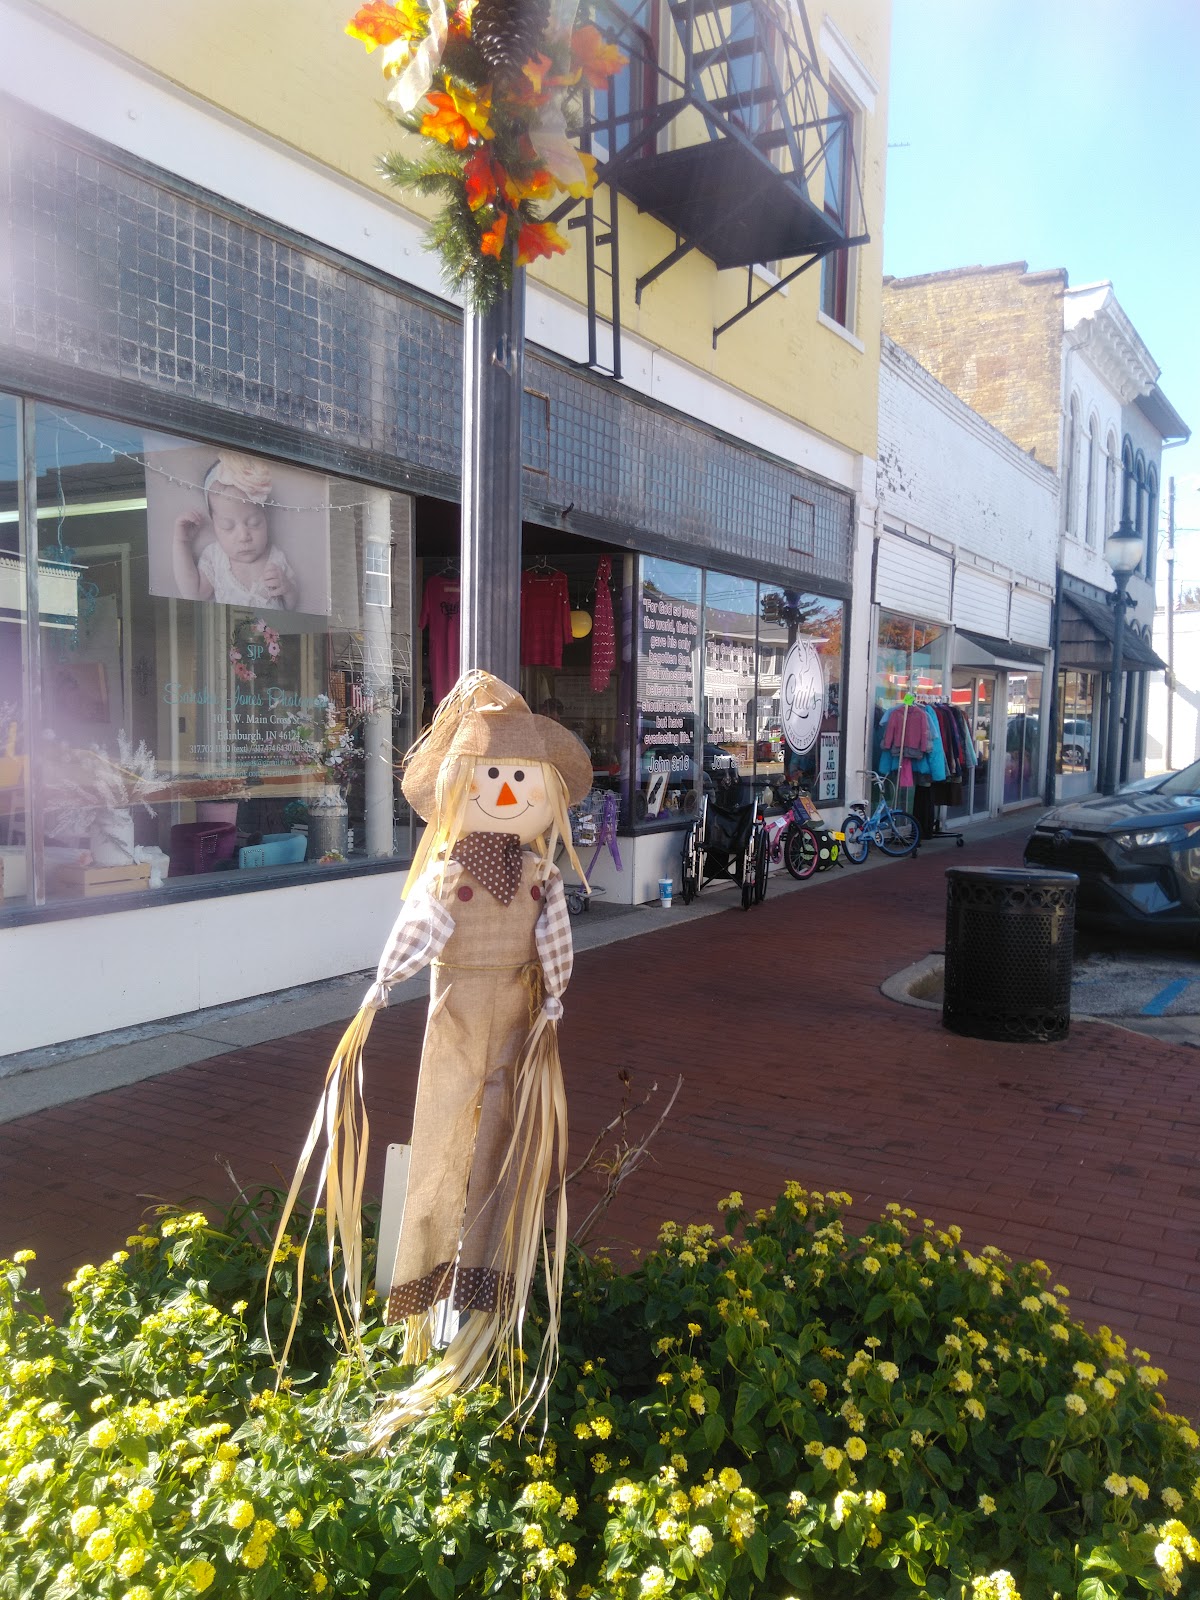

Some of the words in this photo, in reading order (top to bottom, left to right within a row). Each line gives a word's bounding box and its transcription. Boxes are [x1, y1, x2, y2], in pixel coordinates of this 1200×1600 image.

[643, 598, 658, 613] "For
[659, 601, 672, 615] God
[673, 606, 681, 617] so
[682, 605, 698, 619] loved
[644, 616, 655, 629] the
[656, 619, 675, 634] world,
[676, 621, 688, 634] that
[689, 622, 697, 635] he
[651, 636, 666, 649] gave
[667, 635, 677, 648] his
[678, 638, 691, 652] only
[247, 645, 264, 660] SJP
[649, 650, 677, 665] begotten
[646, 666, 660, 679] that
[223, 684, 263, 710] Jones
[785, 673, 821, 721] Gail's
[642, 699, 664, 712] should
[665, 701, 675, 712] not
[232, 714, 244, 724] W.
[246, 713, 267, 724] Main
[656, 716, 667, 728] but
[668, 716, 683, 728] have
[217, 729, 263, 743] Edinburgh,
[266, 730, 277, 740] IN
[279, 730, 300, 740] 46124
[644, 731, 678, 746] everlasting
[821, 735, 840, 747] TODAY
[828, 749, 834, 760] 10
[648, 756, 670, 773] John
[826, 761, 835, 770] AND
[823, 771, 837, 780] UNDER
[826, 783, 835, 796] $2
